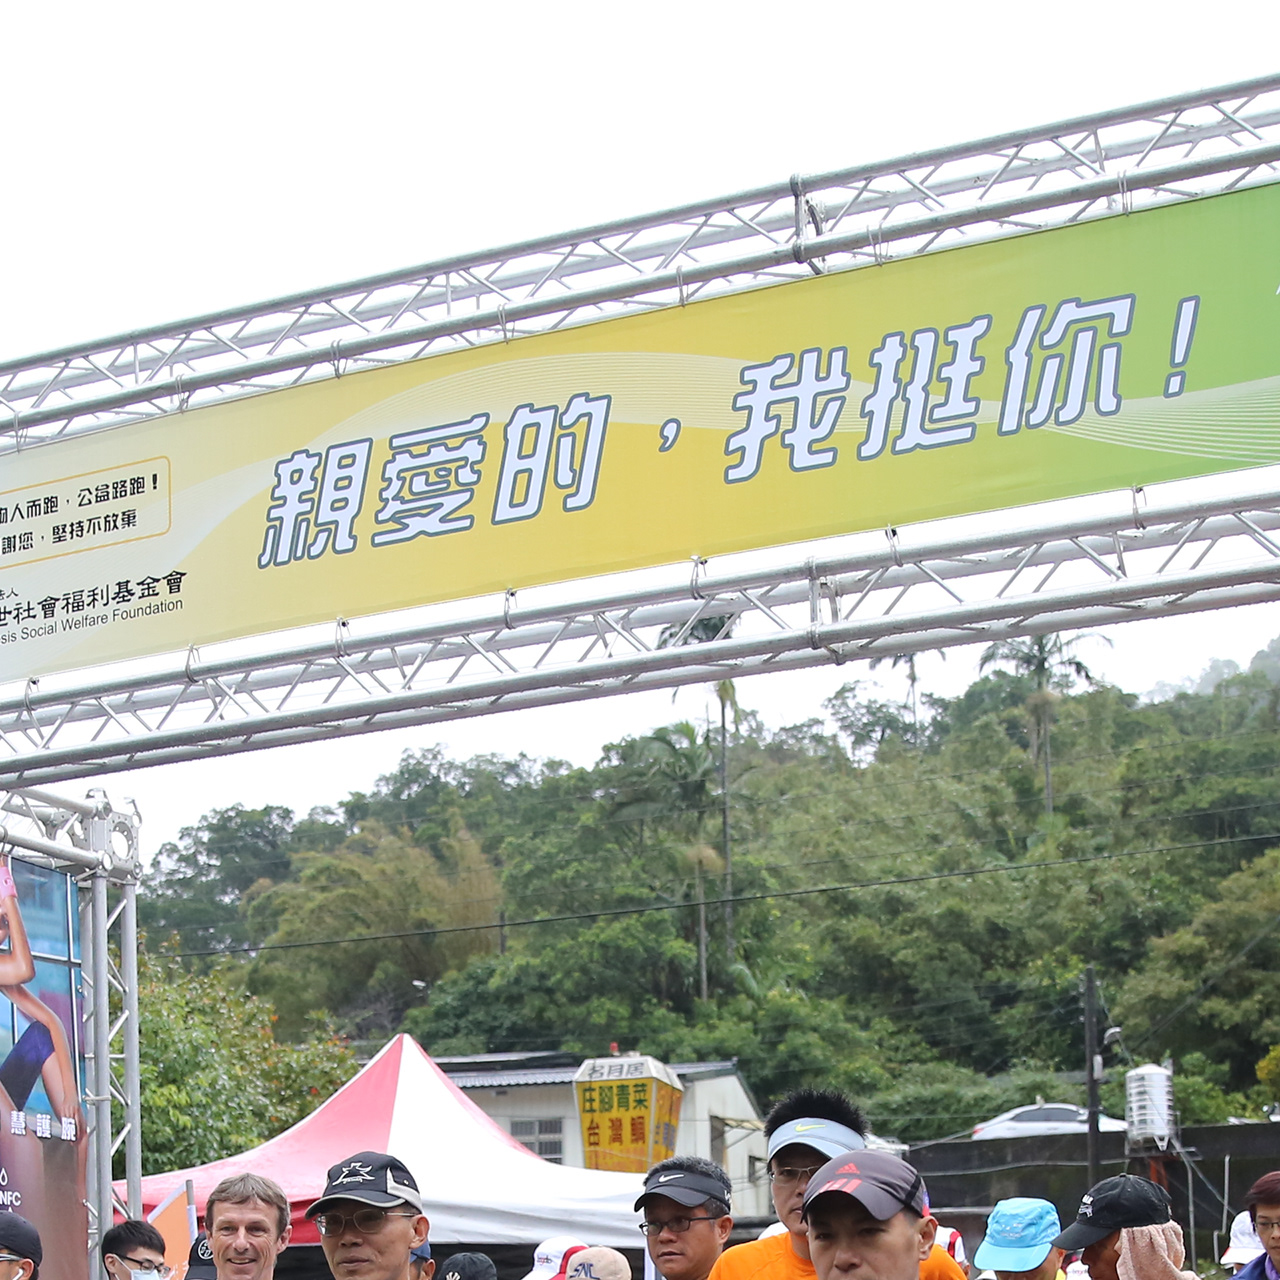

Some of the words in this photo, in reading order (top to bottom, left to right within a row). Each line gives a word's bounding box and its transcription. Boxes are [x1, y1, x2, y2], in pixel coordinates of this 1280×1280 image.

[21, 621, 58, 641] Social
[60, 610, 109, 632] Welfare
[112, 597, 184, 623] Foundation
